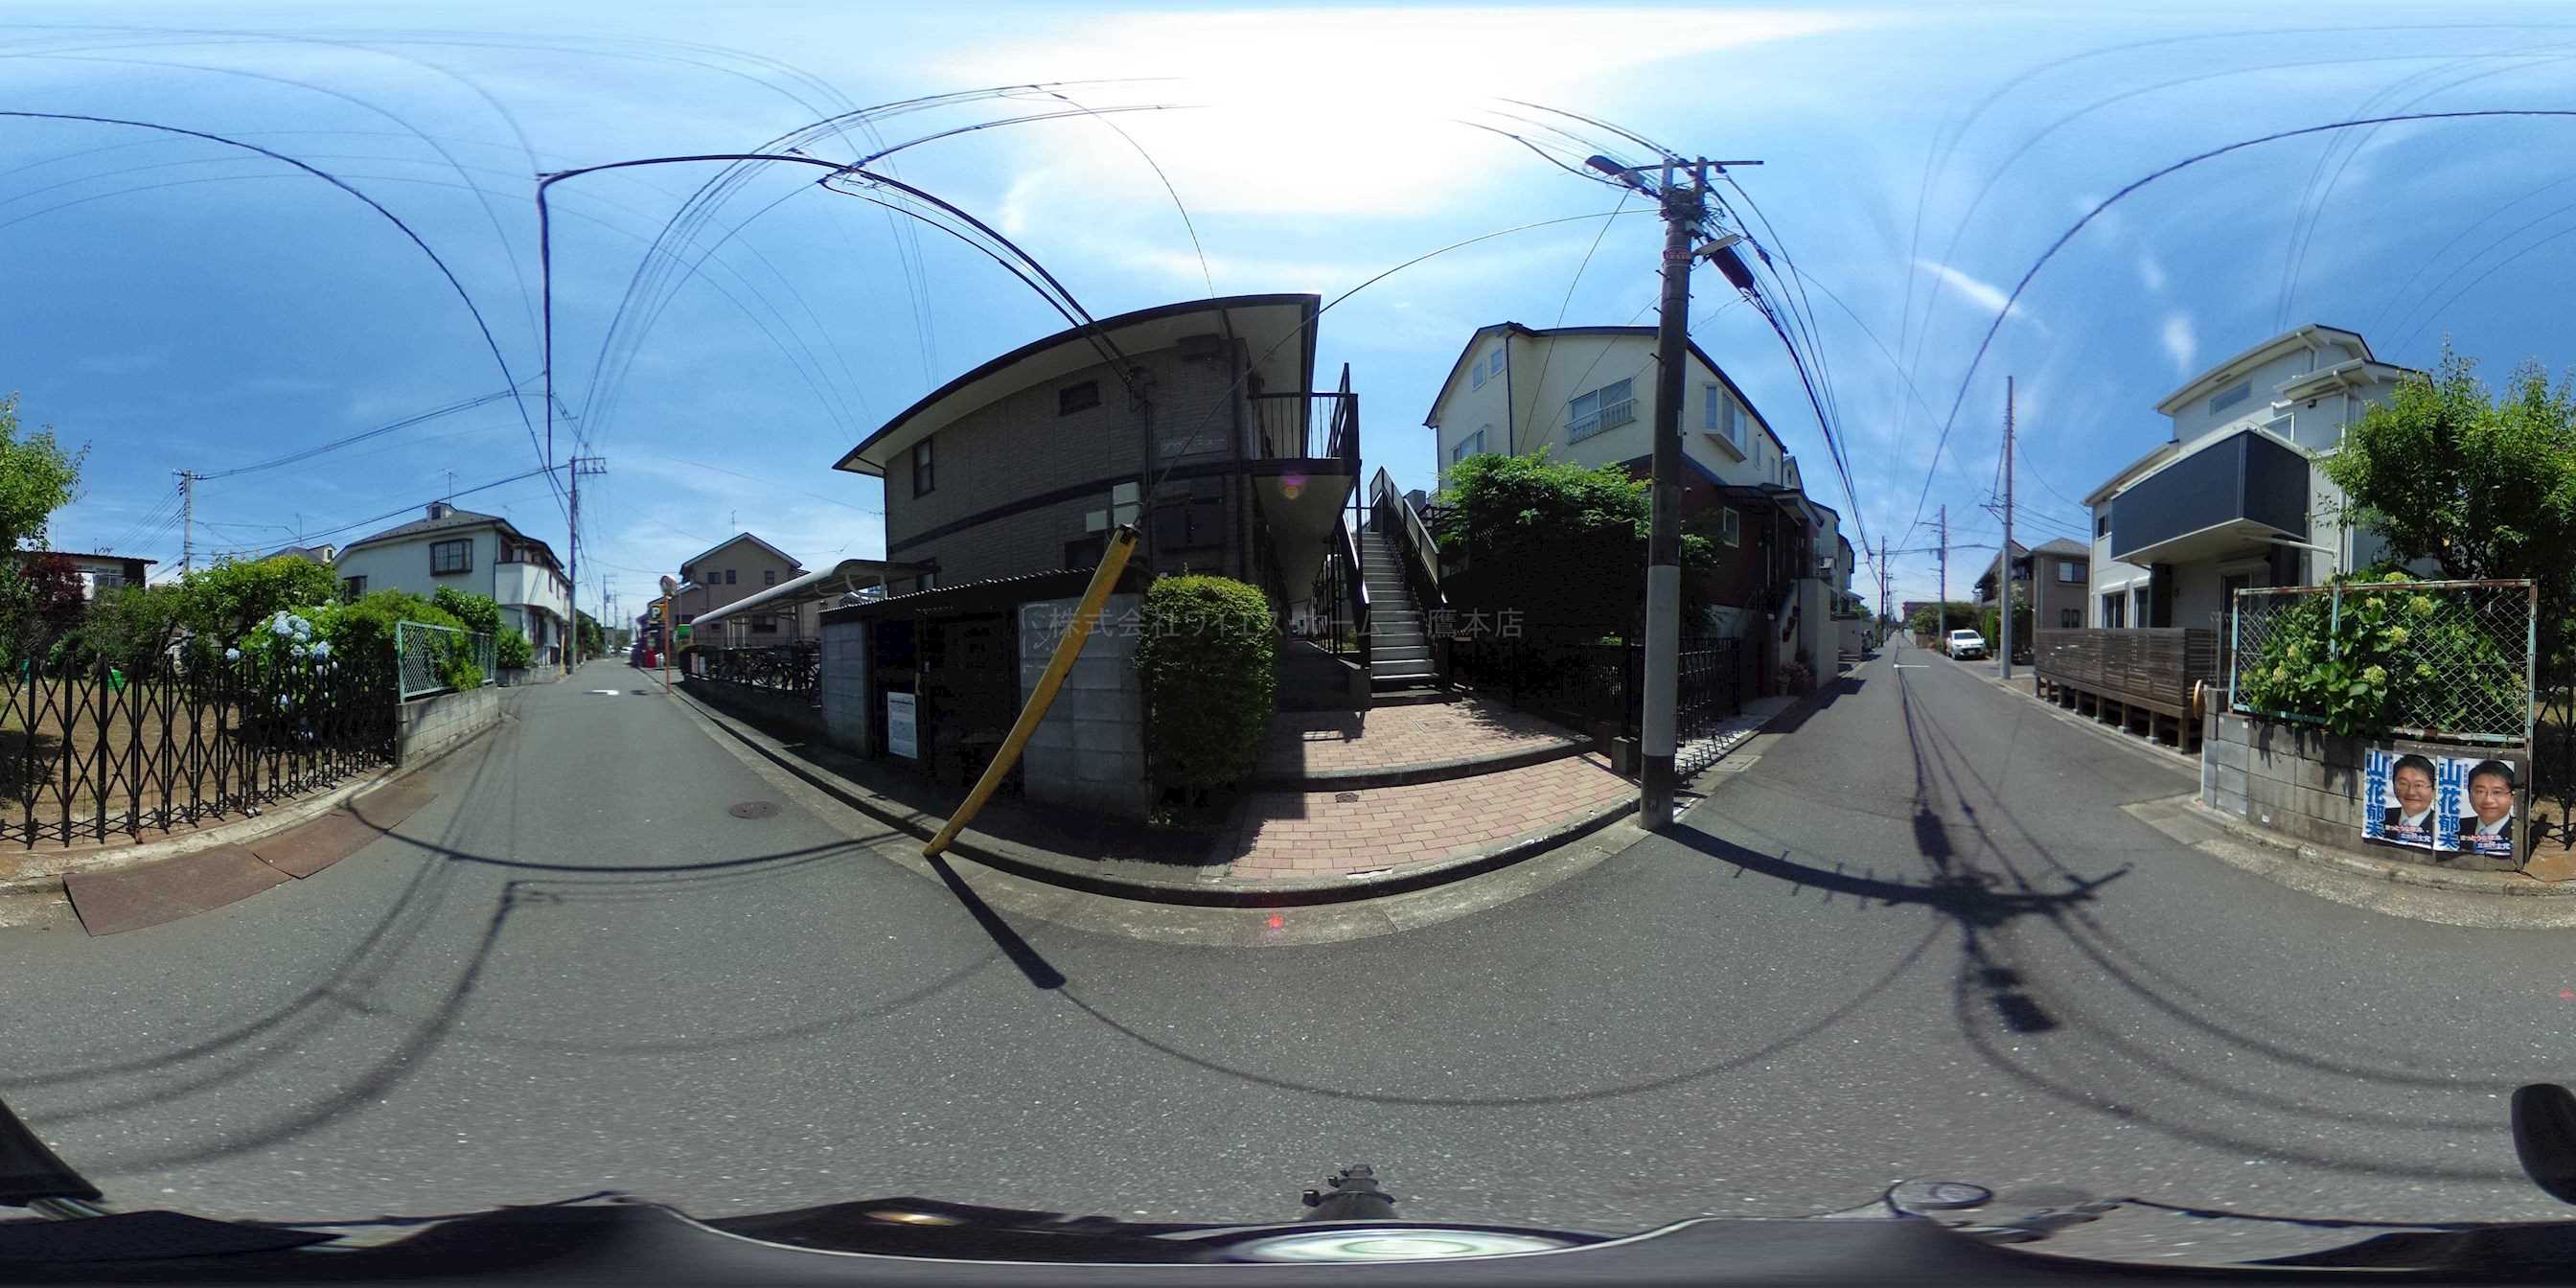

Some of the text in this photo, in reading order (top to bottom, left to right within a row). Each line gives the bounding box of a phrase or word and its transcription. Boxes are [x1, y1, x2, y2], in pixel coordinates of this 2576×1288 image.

[651, 607, 661, 619] P
[2366, 750, 2388, 839] 山花郁夫
[2437, 758, 2461, 850] 山花郁夫
